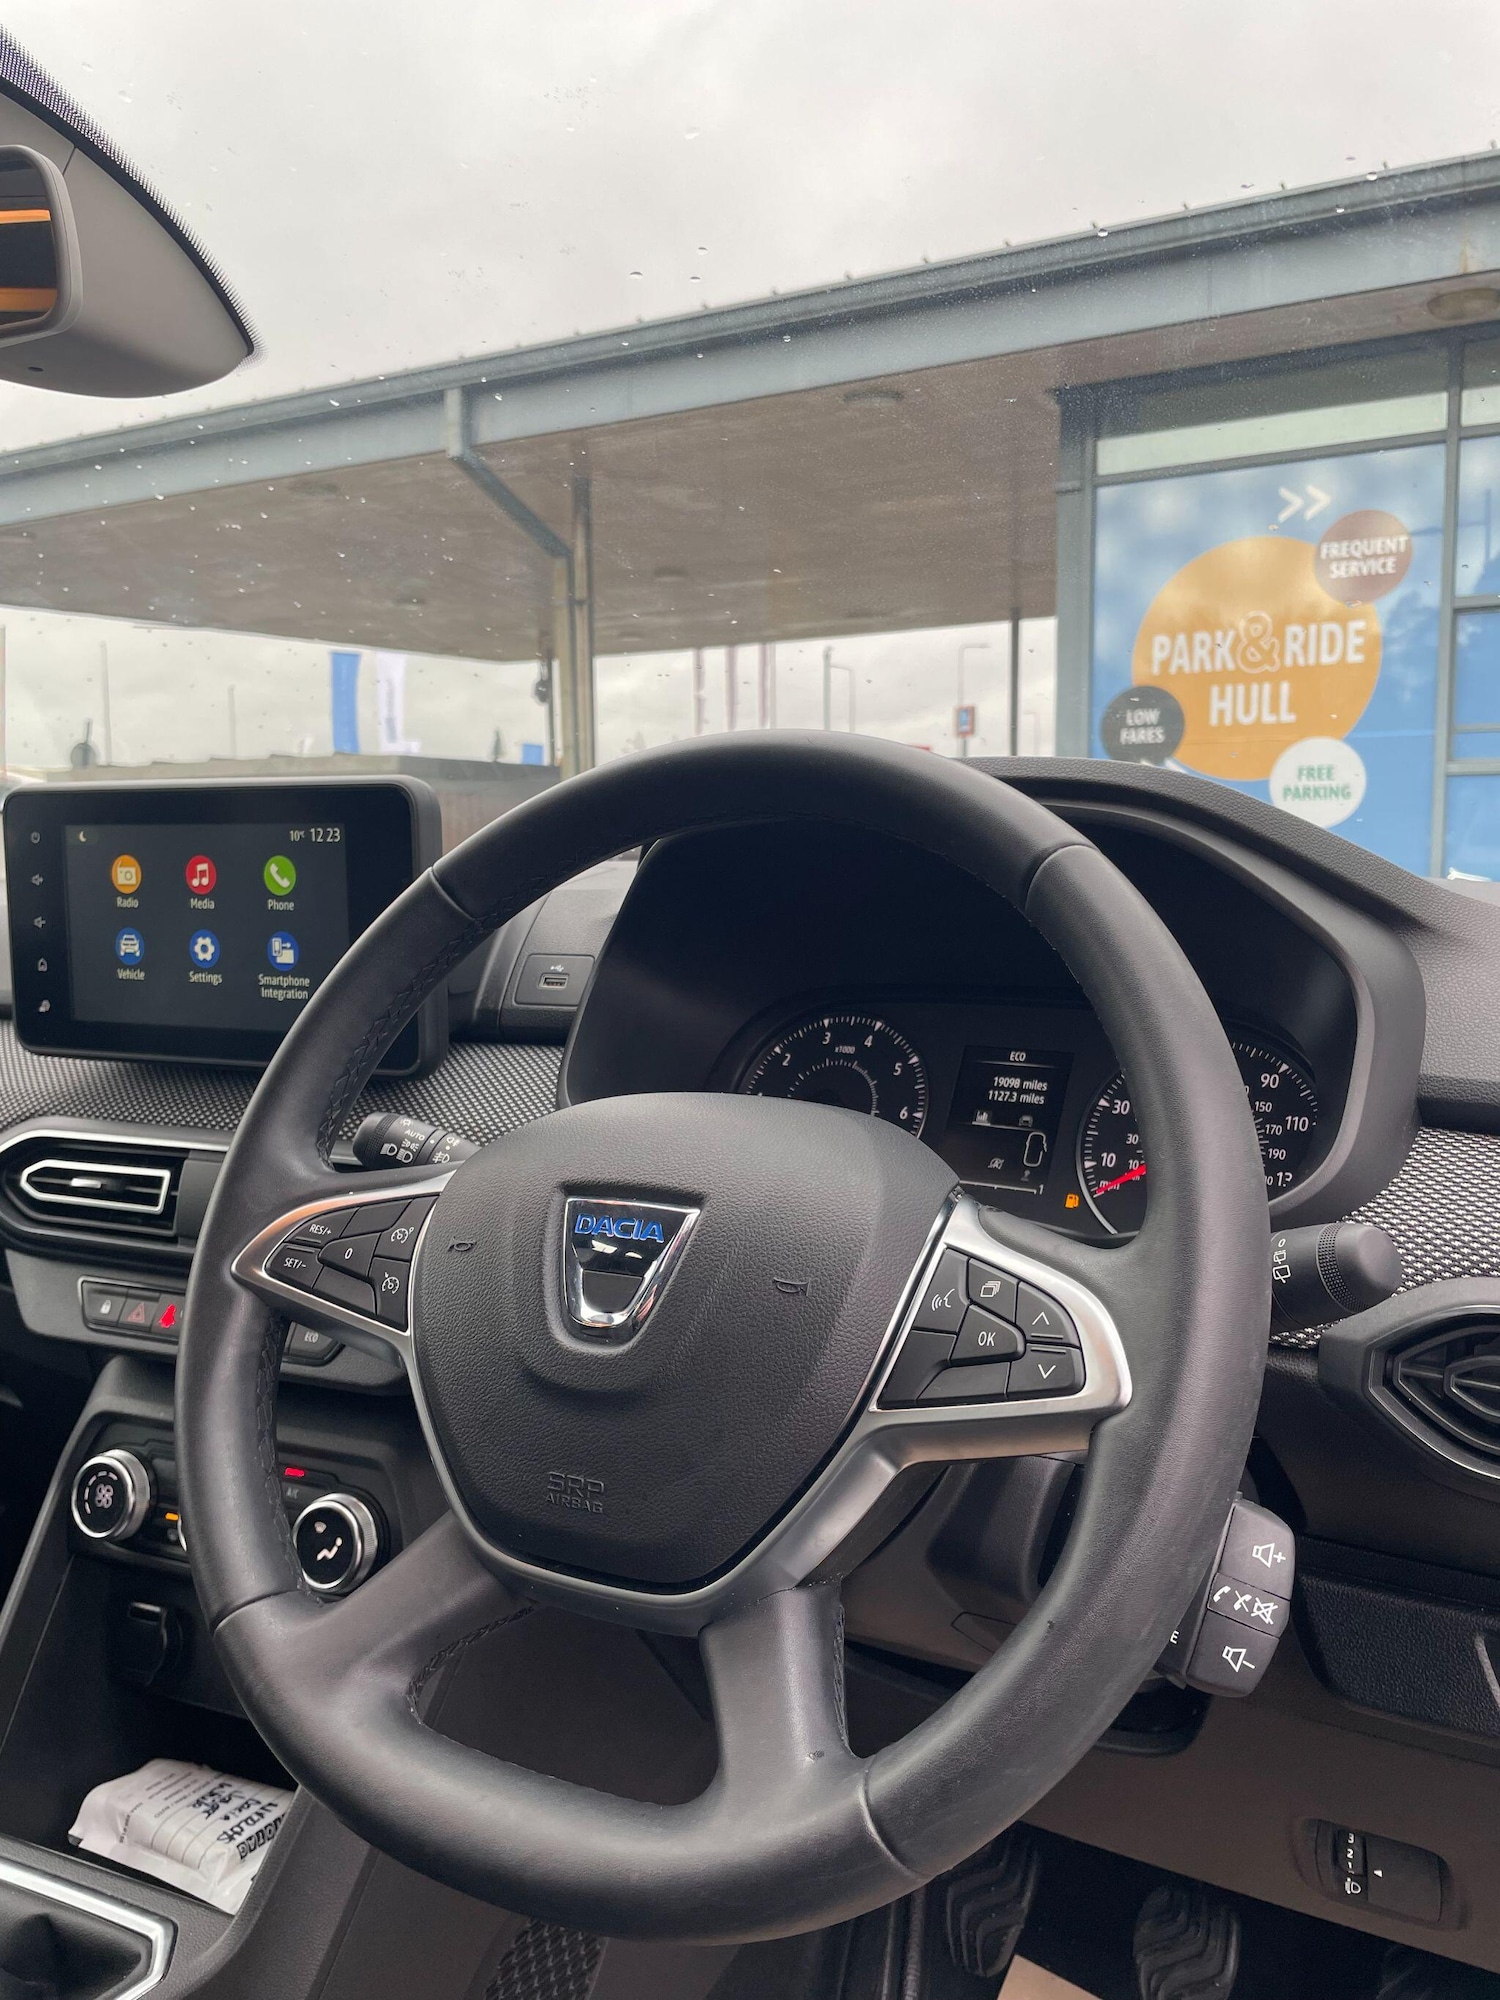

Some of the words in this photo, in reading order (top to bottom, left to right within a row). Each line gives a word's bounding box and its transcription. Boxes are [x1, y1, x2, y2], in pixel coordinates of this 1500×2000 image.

[1319, 536, 1409, 560] FREQUENT
[1329, 557, 1396, 579] SERVICE
[1209, 681, 1296, 727] HULL
[1126, 708, 1160, 727] LOW
[1119, 726, 1165, 745] FARES
[1298, 764, 1335, 782] FREE
[1282, 785, 1352, 802] PARKING
[116, 896, 139, 909] Radio
[190, 897, 215, 910] Media
[267, 898, 295, 911] Phone
[117, 967, 145, 981] Vehicle
[189, 970, 223, 986] Settings
[258, 972, 310, 988] Smartphone
[261, 987, 309, 1001] Integration
[822, 1031, 831, 1045] 3
[864, 1034, 874, 1048] 4
[782, 1053, 791, 1066] 2
[1009, 1050, 1026, 1062] ECO
[893, 1062, 902, 1076] 5
[993, 1075, 1020, 1089] 19098
[1022, 1078, 1048, 1092] miles
[1260, 1073, 1280, 1089] 90
[988, 1089, 1017, 1103] 1127.3
[1019, 1093, 1045, 1105] miles
[899, 1106, 908, 1120] 6
[1112, 1099, 1130, 1115] 30
[1254, 1101, 1272, 1113] 150
[1265, 1124, 1282, 1136] 170
[1285, 1115, 1309, 1132] 110
[405, 1128, 426, 1141] AUTO
[1126, 1133, 1139, 1145] 30
[1101, 1152, 1116, 1168] 10
[1268, 1148, 1286, 1160] 190
[1128, 1159, 1139, 1170] 10
[574, 1213, 665, 1243] DACIA
[304, 1331, 319, 1343] ECO
[978, 1331, 996, 1347] OK
[546, 1492, 604, 1514] AIRBAG
[1347, 1832, 1355, 1844] 3
[1346, 1848, 1354, 1859] 2
[1347, 1861, 1352, 1869] 1
